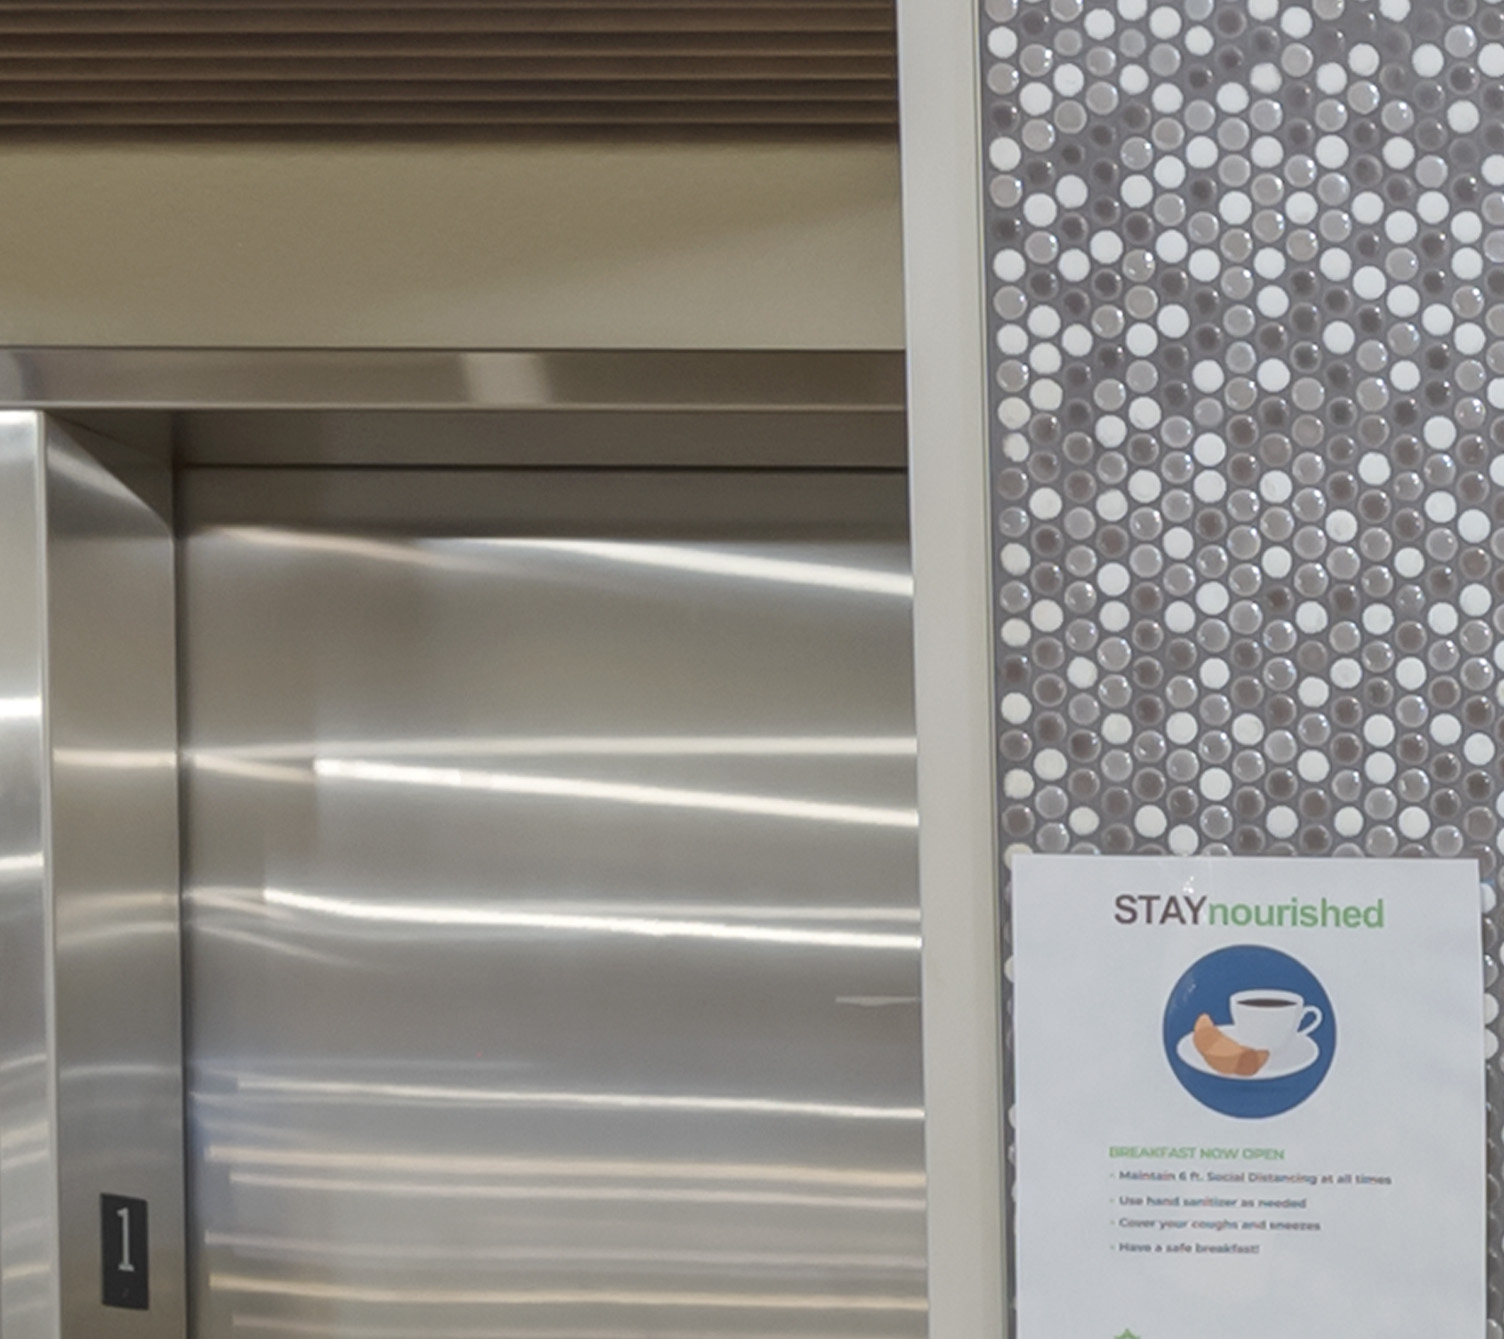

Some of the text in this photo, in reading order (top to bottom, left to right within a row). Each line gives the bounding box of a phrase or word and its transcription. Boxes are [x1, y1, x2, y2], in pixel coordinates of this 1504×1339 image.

[1109, 1146, 1285, 1160] BREAKFAST NOW OPEN
[1119, 1170, 1175, 1182] Maintain
[1179, 1171, 1187, 1182] 6
[1207, 1171, 1244, 1183] Social
[1248, 1172, 1317, 1186] Distancing
[1320, 1174, 1333, 1184] at
[1337, 1174, 1351, 1184] all
[1355, 1174, 1392, 1185] times
[1119, 1196, 1307, 1209] Use hand sanitizer as needed
[1119, 1217, 1321, 1231] Cover your coughs and sneezes
[117, 1207, 134, 1272] 1
[1119, 1242, 1152, 1253] Have
[1155, 1245, 1163, 1253] a
[1166, 1243, 1192, 1253] safe
